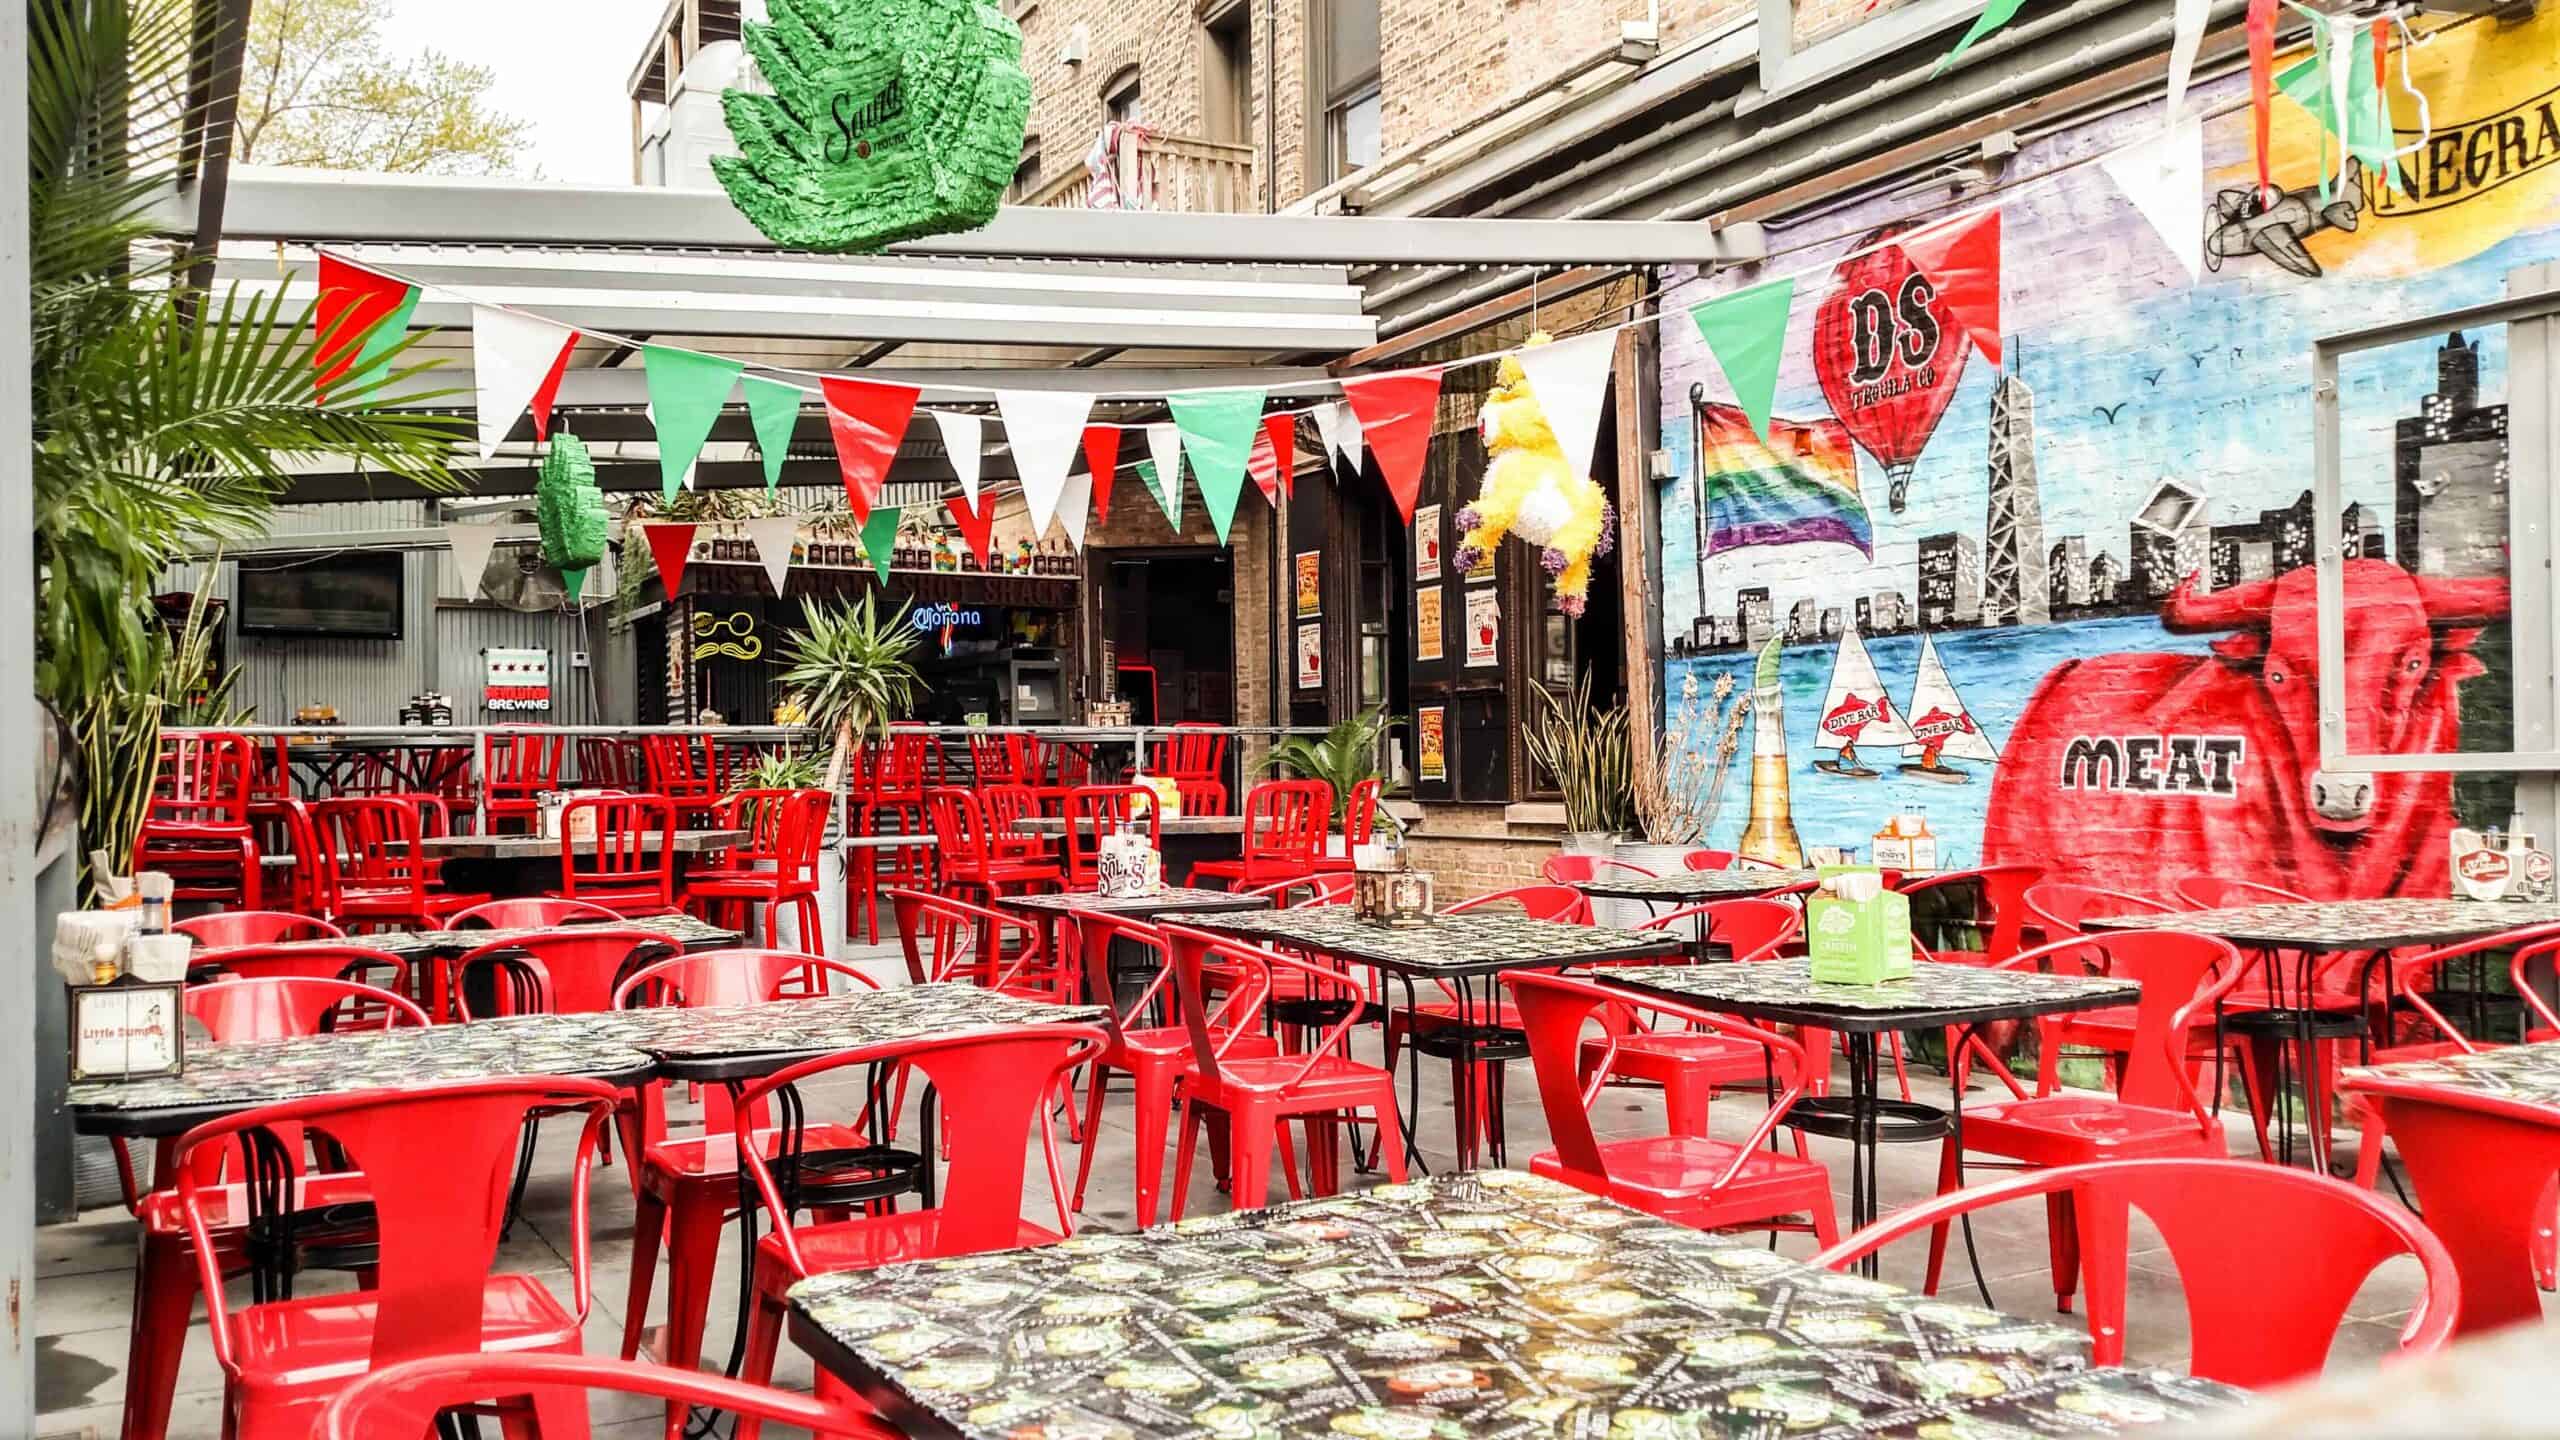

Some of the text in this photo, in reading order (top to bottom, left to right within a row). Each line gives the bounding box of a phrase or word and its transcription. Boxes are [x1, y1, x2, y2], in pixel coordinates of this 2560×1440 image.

[824, 79, 904, 165] Sauza
[2379, 101, 2560, 210] NEGRA
[1850, 271, 1940, 385] DS
[912, 607, 981, 631] Corona
[487, 699, 550, 711] BREWING
[1830, 705, 1879, 729] DIVE BAR
[1914, 718, 1963, 738] DIVE BAR
[2062, 734, 2244, 799] MEAT
[83, 1026, 116, 1040] Little
